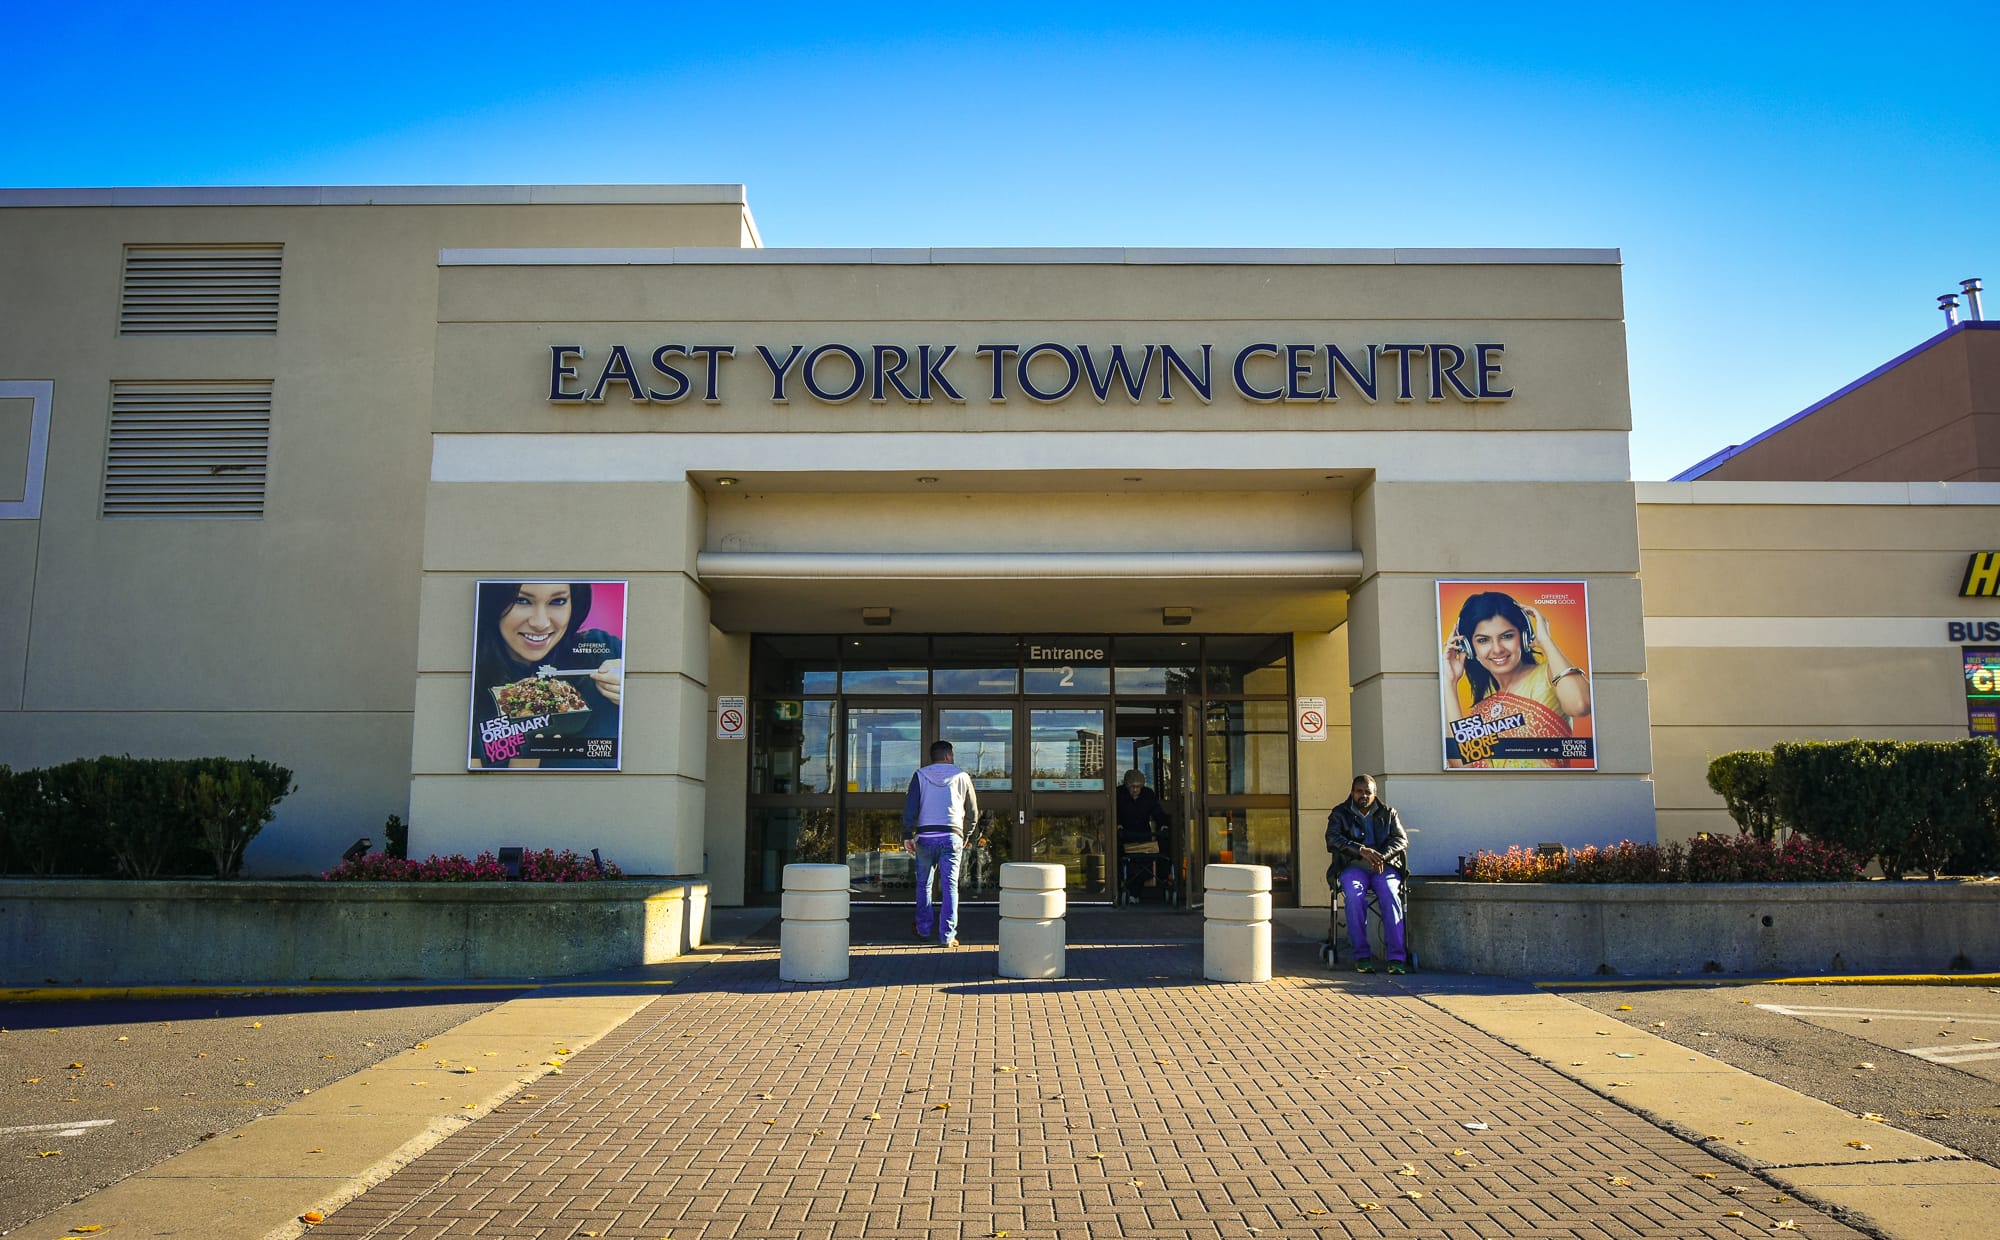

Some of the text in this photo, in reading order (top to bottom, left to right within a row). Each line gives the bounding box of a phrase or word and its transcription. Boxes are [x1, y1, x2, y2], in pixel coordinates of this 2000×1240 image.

[548, 343, 1515, 404] EAST YORK TOWN CENTRE
[1959, 552, 2000, 597] H
[1030, 646, 1104, 660] Entrance
[1059, 666, 1074, 687] 2
[1972, 669, 2000, 692] C
[480, 715, 510, 734] LESS
[482, 714, 550, 743] ORDINARY
[1451, 715, 1482, 734] LESS
[1455, 714, 1522, 743] ORDINARY
[485, 732, 526, 754] MORE
[1458, 732, 1500, 754] MORE
[1461, 745, 1495, 763] YOU.
[486, 745, 520, 764] YOU.
